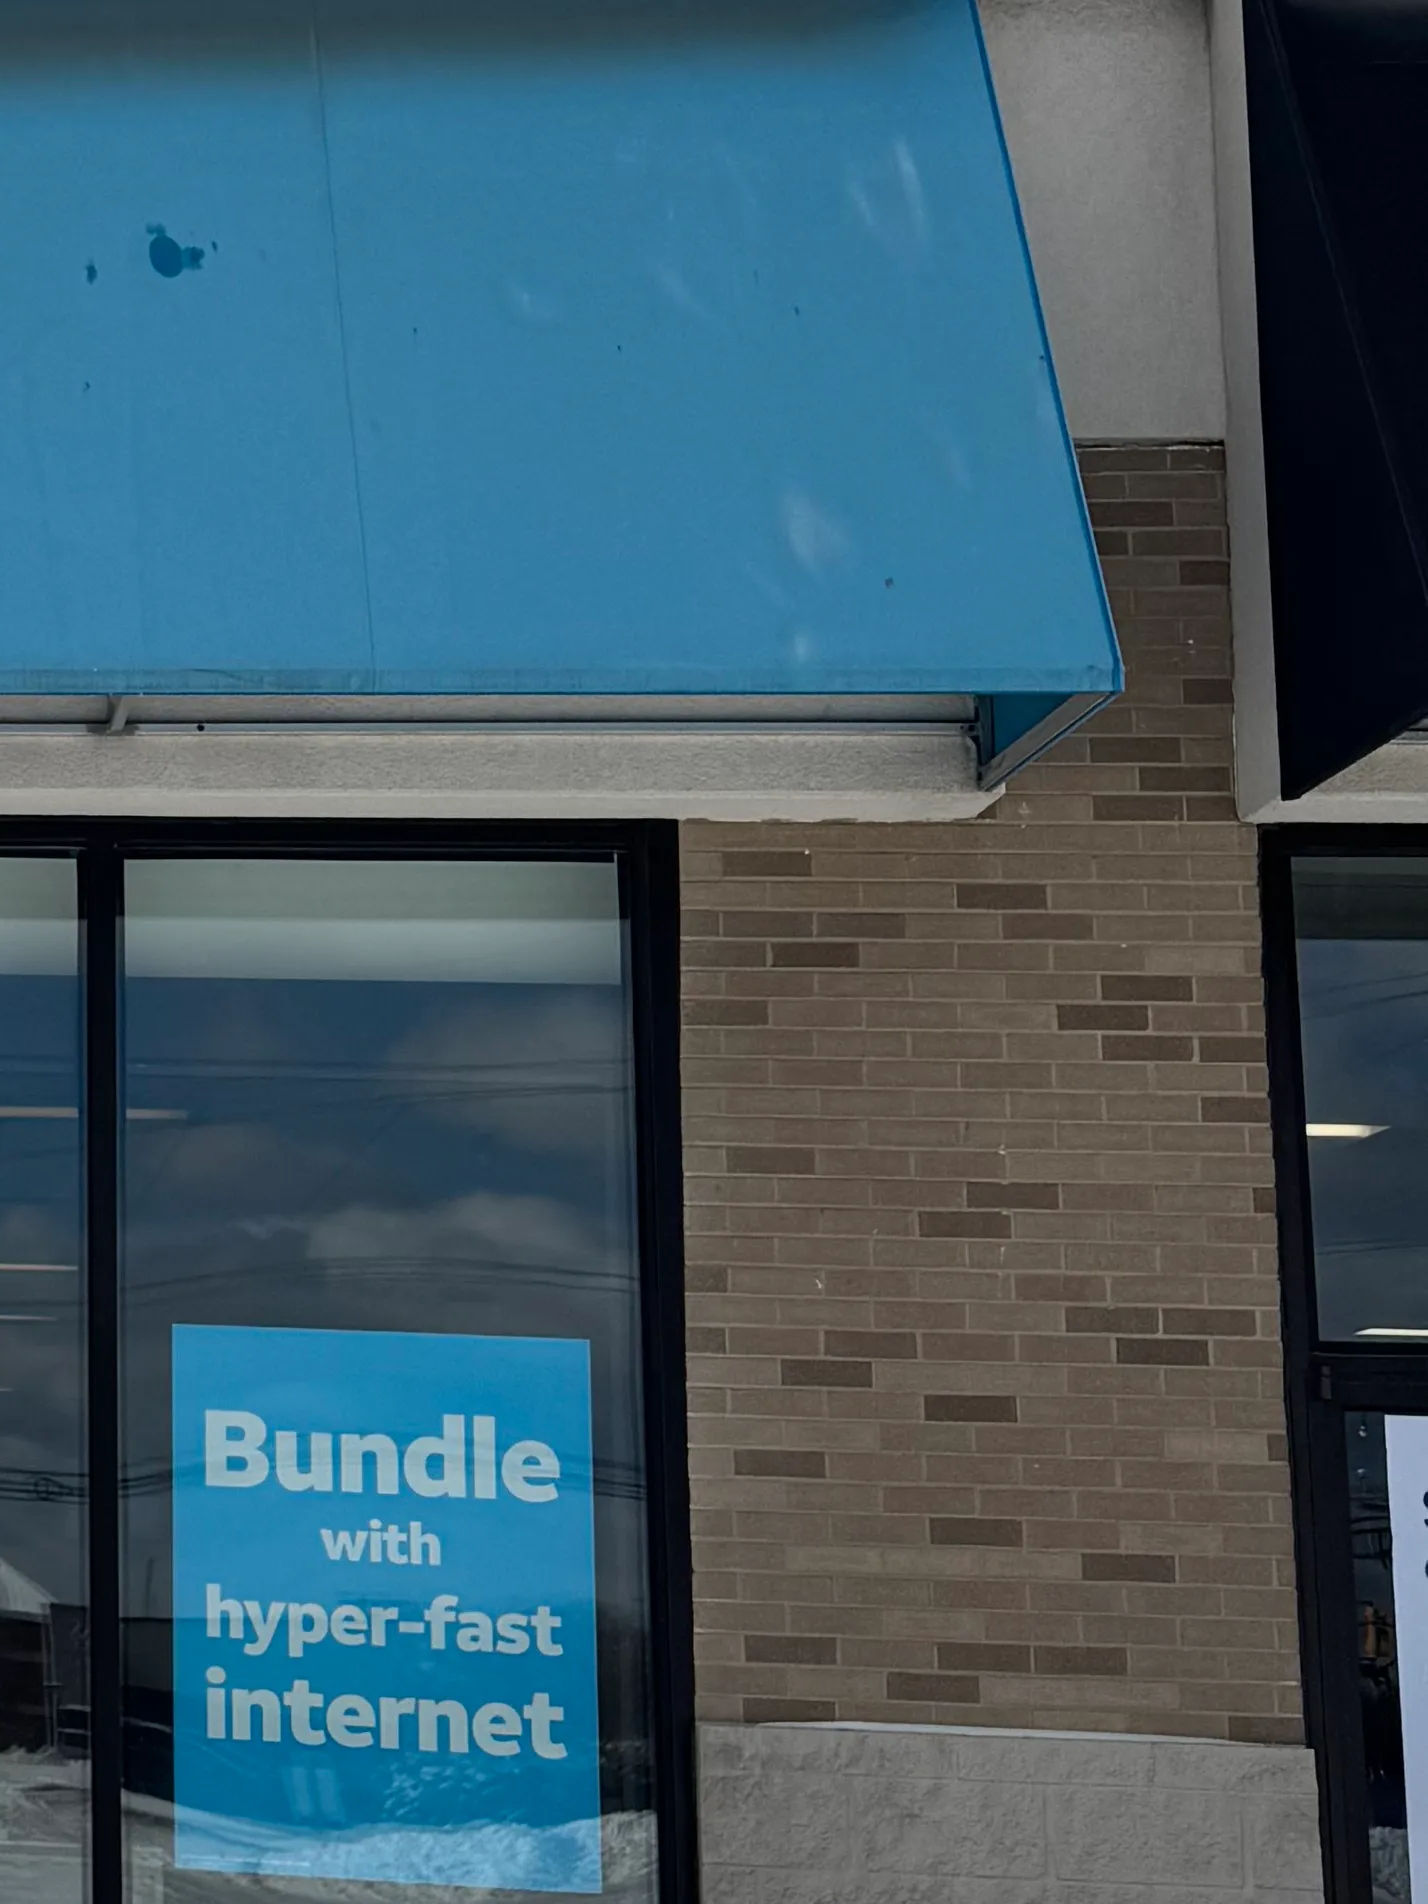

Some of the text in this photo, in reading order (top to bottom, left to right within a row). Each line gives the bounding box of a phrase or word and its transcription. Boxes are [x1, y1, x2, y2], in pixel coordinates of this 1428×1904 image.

[204, 1409, 561, 1503] Bundle
[320, 1518, 442, 1567] with
[205, 1583, 564, 1658] hyper-fast
[205, 1668, 568, 1760] internet
